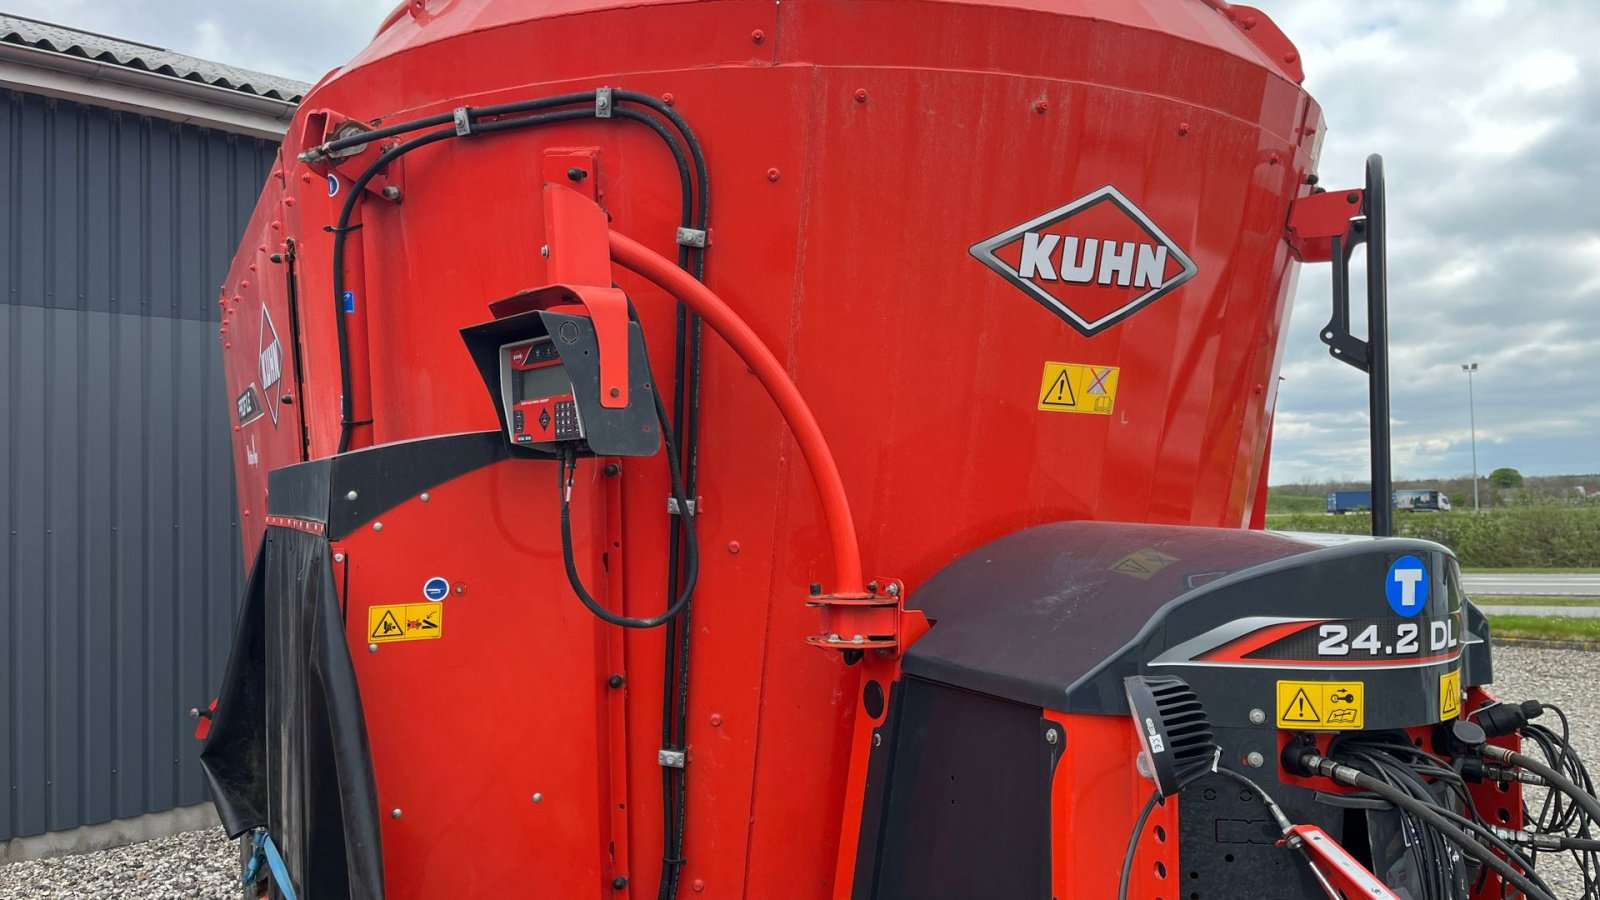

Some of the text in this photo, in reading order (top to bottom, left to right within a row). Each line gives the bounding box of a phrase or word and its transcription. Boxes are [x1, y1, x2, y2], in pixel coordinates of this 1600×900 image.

[1019, 232, 1168, 290] KUHN
[260, 339, 281, 390] KUHN
[1394, 568, 1422, 606] T
[1318, 618, 1457, 656] 24.2 DL
